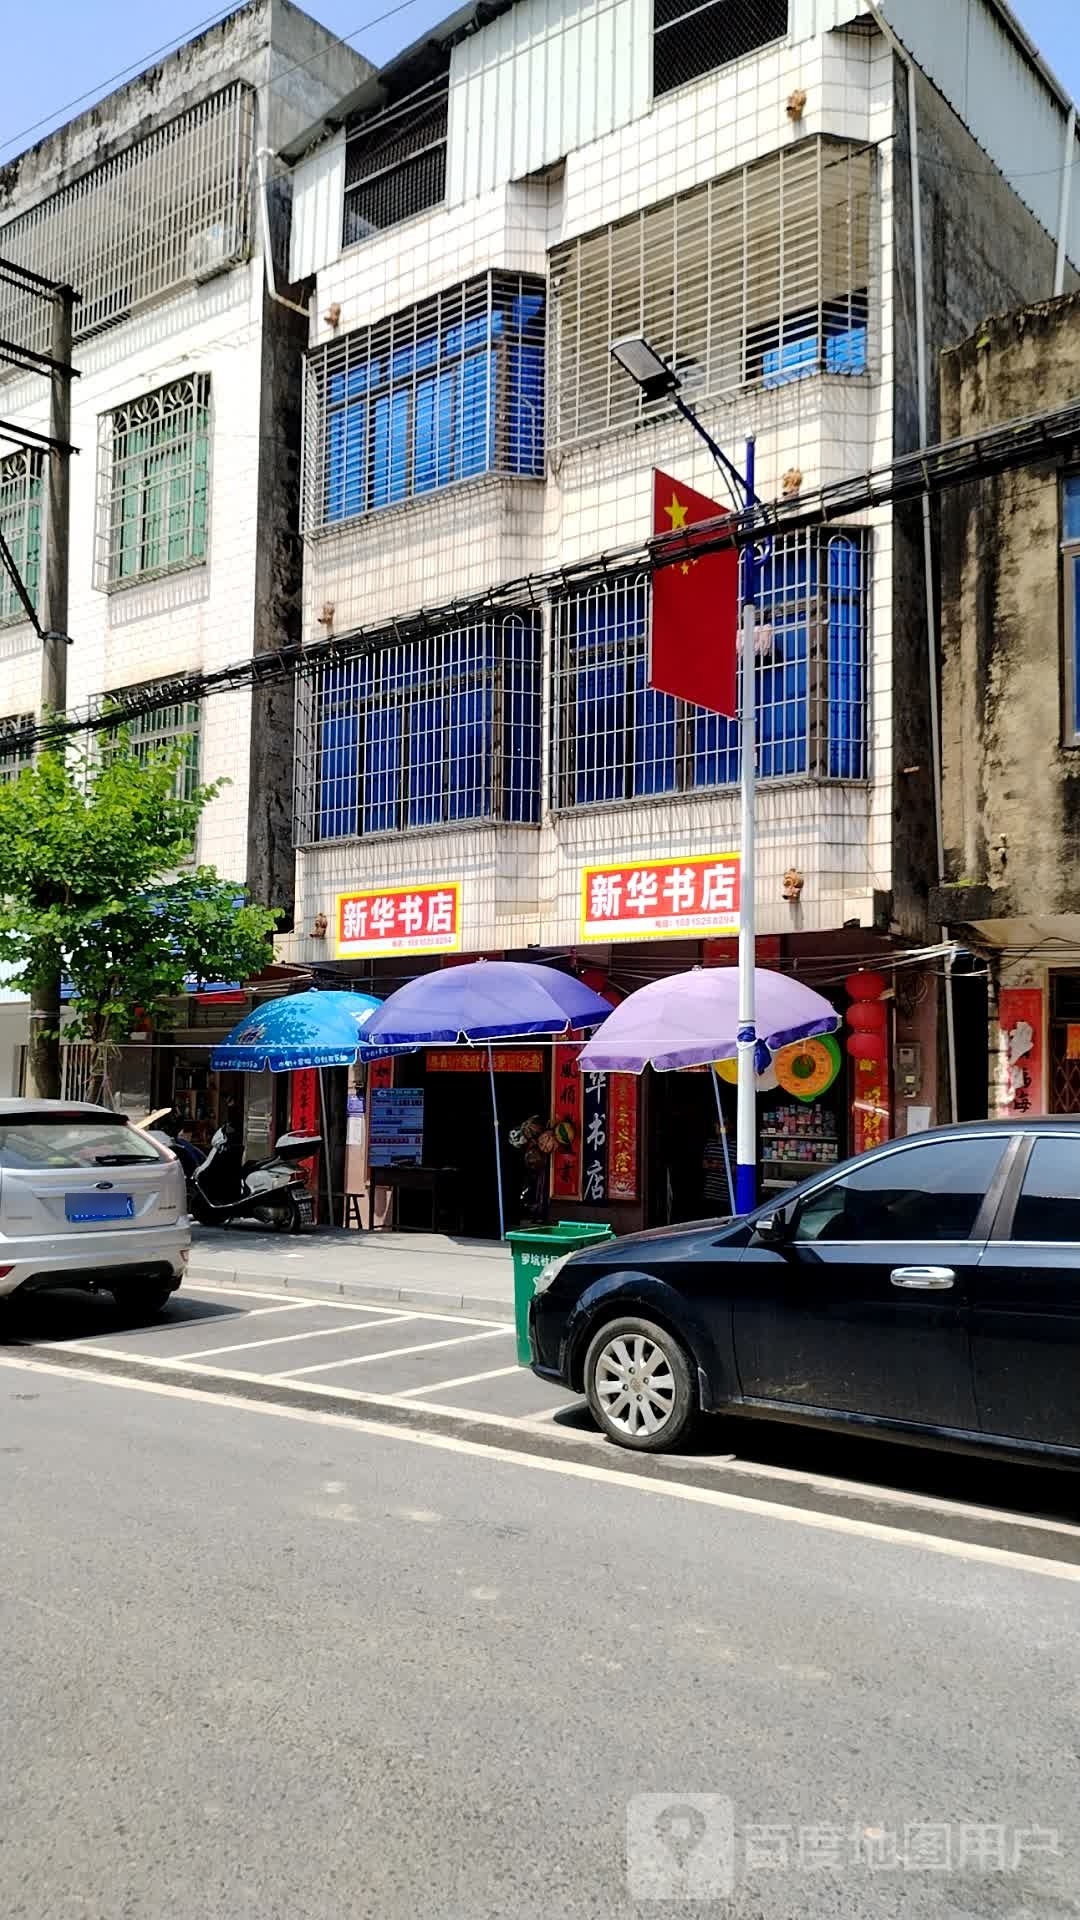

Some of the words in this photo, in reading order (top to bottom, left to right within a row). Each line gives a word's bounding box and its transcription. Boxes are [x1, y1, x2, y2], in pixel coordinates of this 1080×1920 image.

[343, 892, 453, 938] 新华书店
[591, 863, 736, 918] 新华书店
